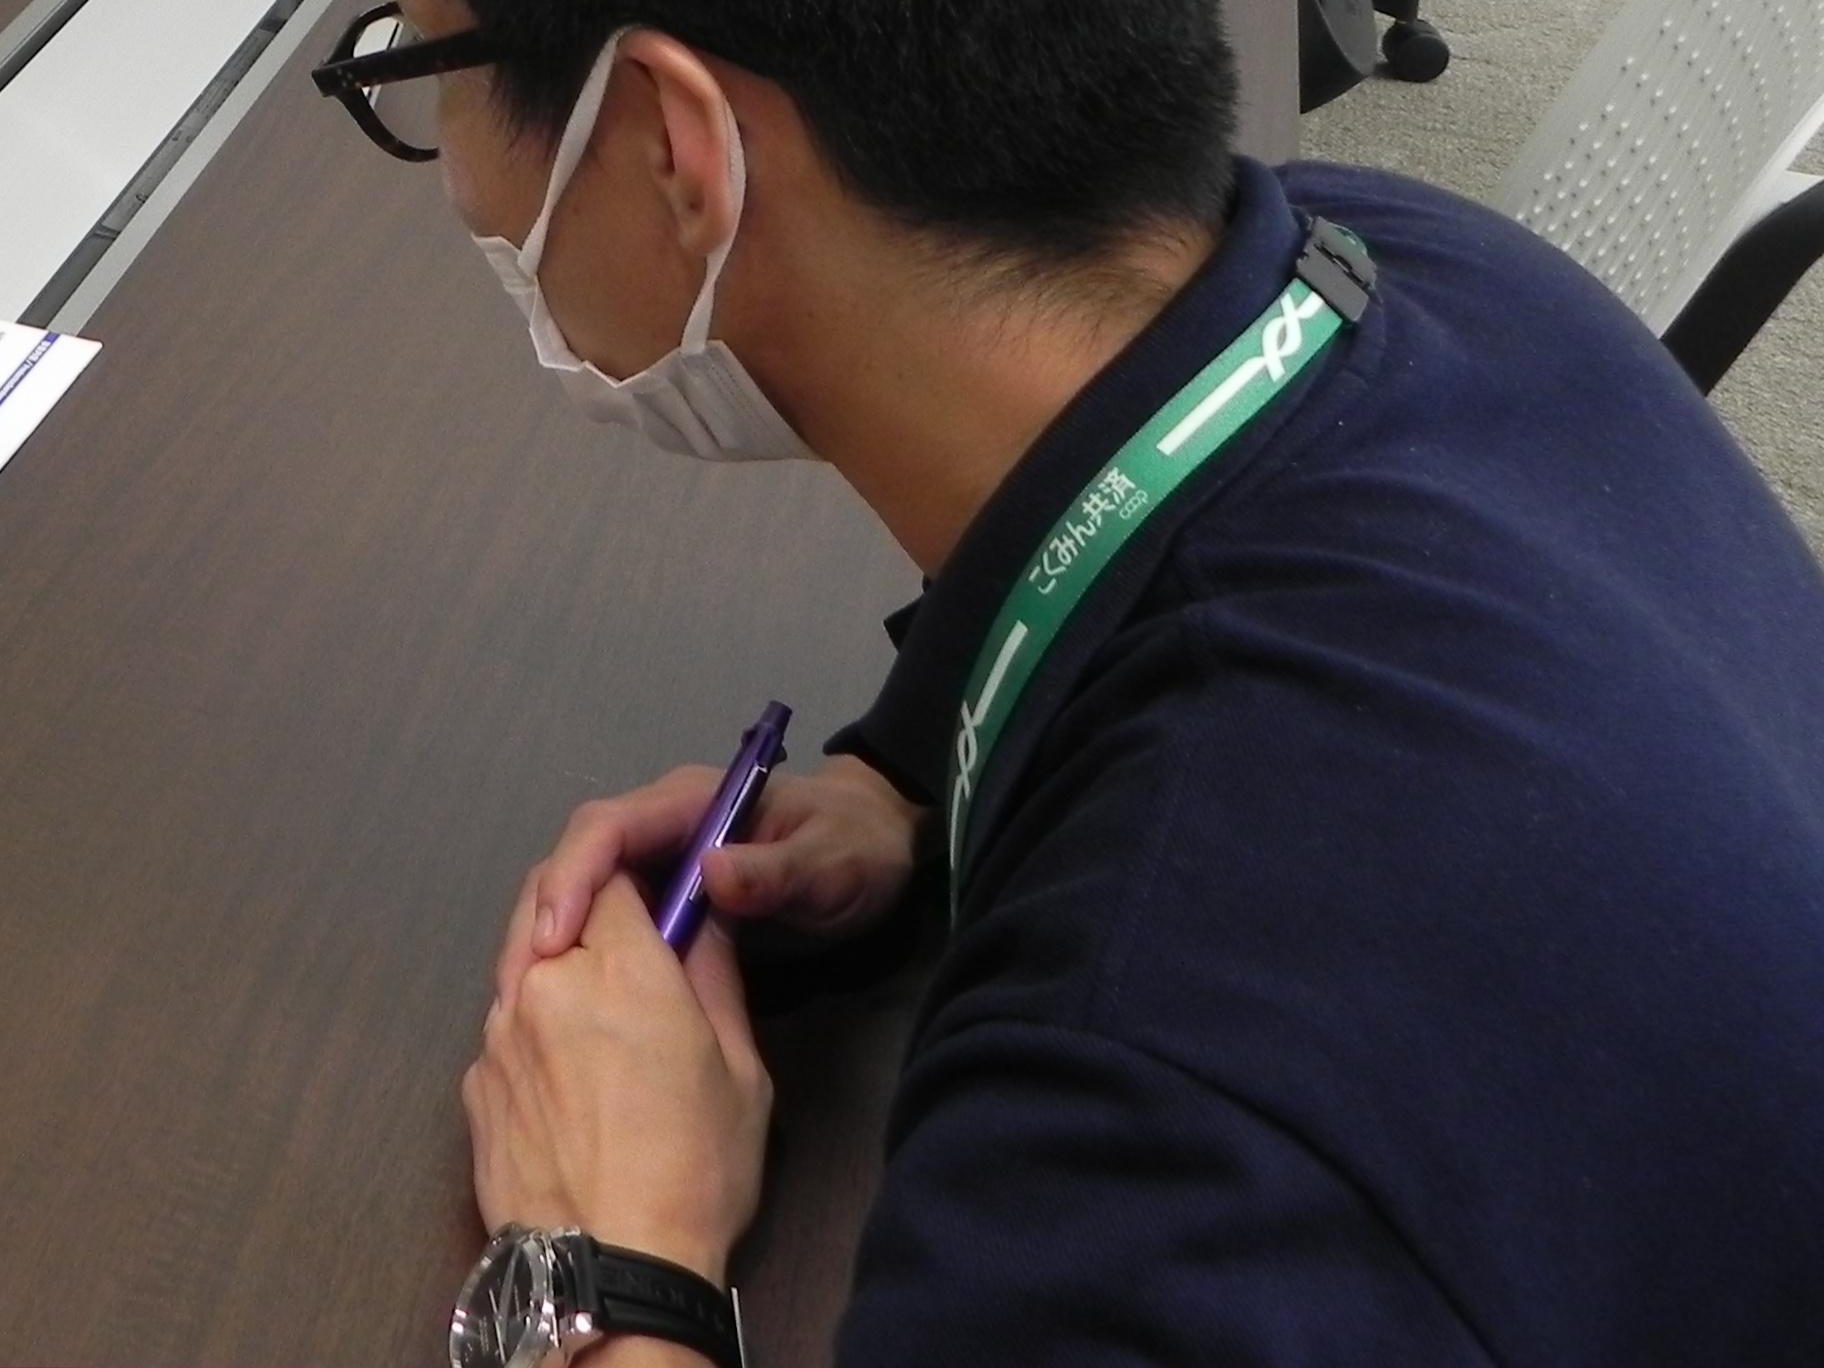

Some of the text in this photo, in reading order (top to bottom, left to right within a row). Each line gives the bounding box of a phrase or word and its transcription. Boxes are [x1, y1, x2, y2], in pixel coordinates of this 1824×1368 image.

[1029, 466, 1136, 595] こくみん共済
[1119, 489, 1149, 520] coop
